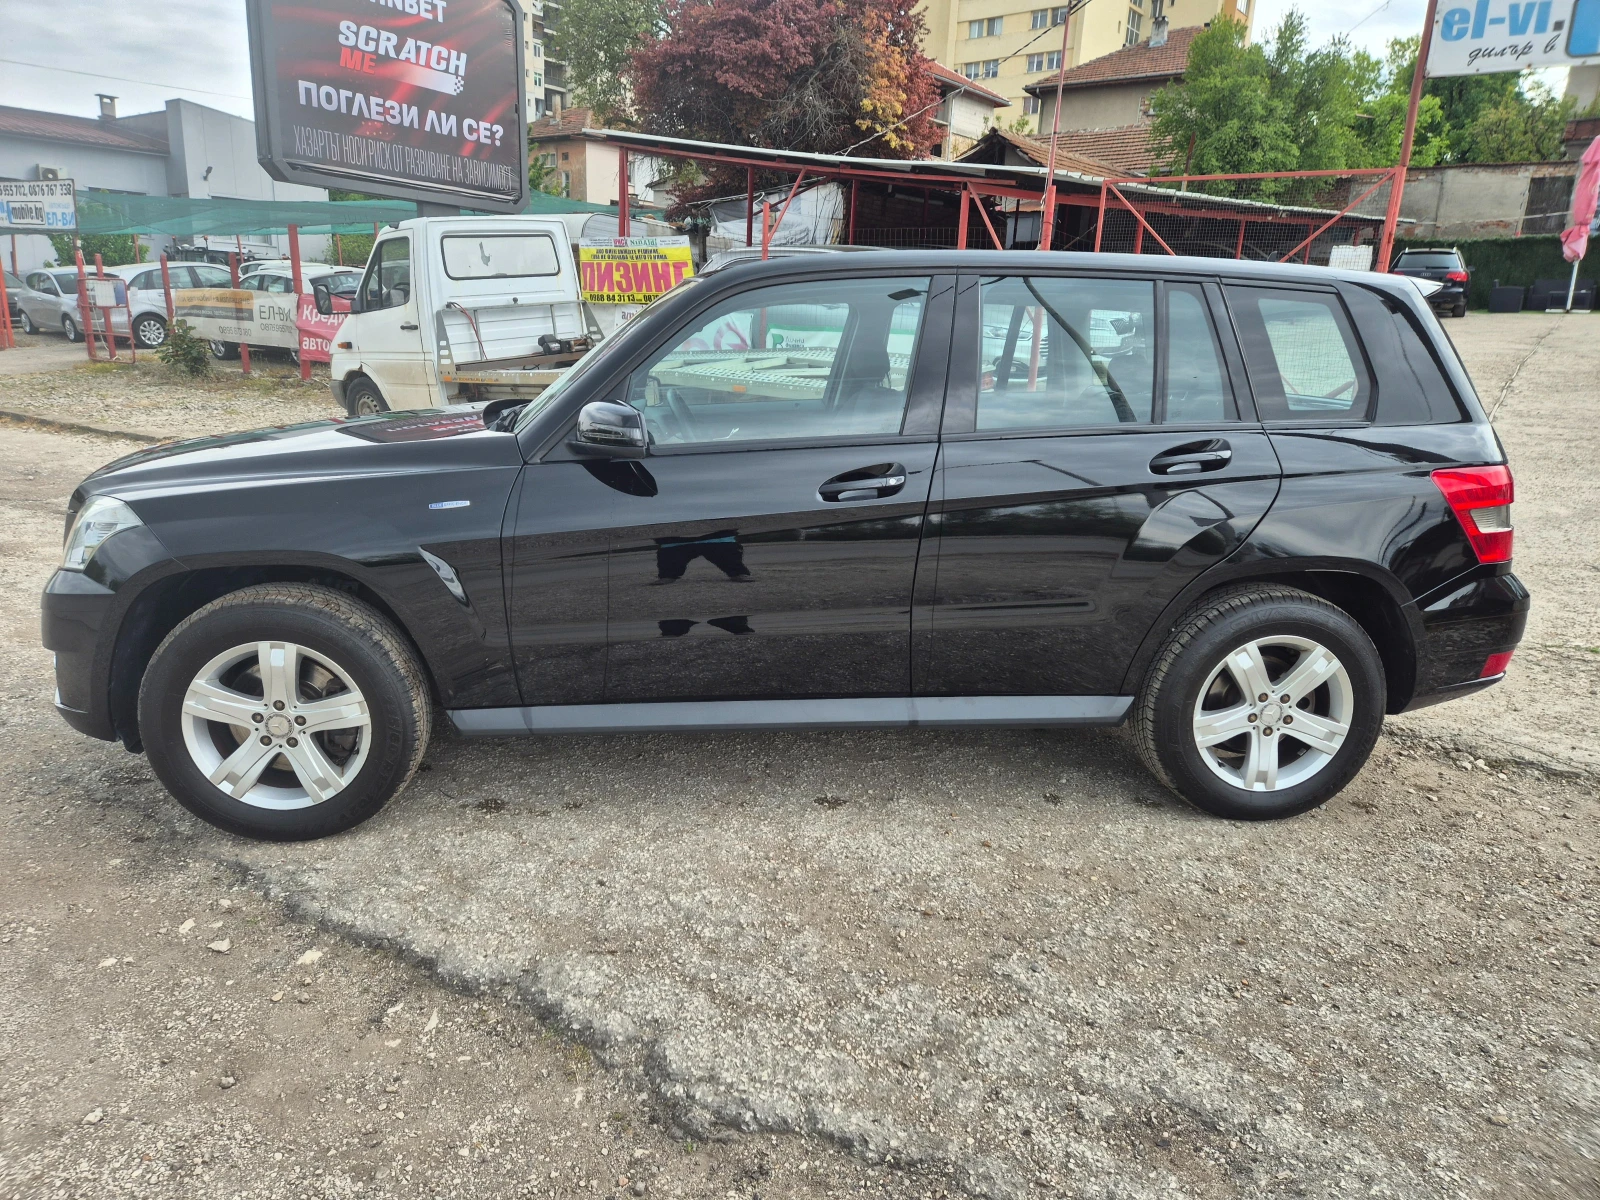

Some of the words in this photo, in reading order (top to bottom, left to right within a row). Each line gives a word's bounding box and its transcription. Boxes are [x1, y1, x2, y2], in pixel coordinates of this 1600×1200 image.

[338, 20, 468, 76] SCRATCH
[339, 46, 377, 75] ME
[1467, 40, 1533, 66] дилър
[298, 79, 419, 129] ПОГЛЕЗИ
[424, 109, 458, 137] ЛИ
[463, 117, 504, 147] СЕ?
[293, 124, 340, 158] ХАЗАРТЪТ
[342, 133, 368, 166] НОСИ
[368, 139, 393, 172] РИСК
[393, 144, 404, 173] ОТ
[405, 146, 452, 182] РАЗВИВАНЕ
[452, 155, 463, 183] НА
[464, 157, 513, 192] ЗАВИСИМОСТ
[11, 203, 44, 222] mobile.bg
[46, 211, 75, 226] ЕЛ-ВИ
[581, 261, 688, 293] ЛИЗИНГ
[606, 293, 616, 303] 84
[617, 294, 625, 302] 31
[627, 294, 636, 303] 13
[259, 304, 292, 322] ЕЛ-ВИ
